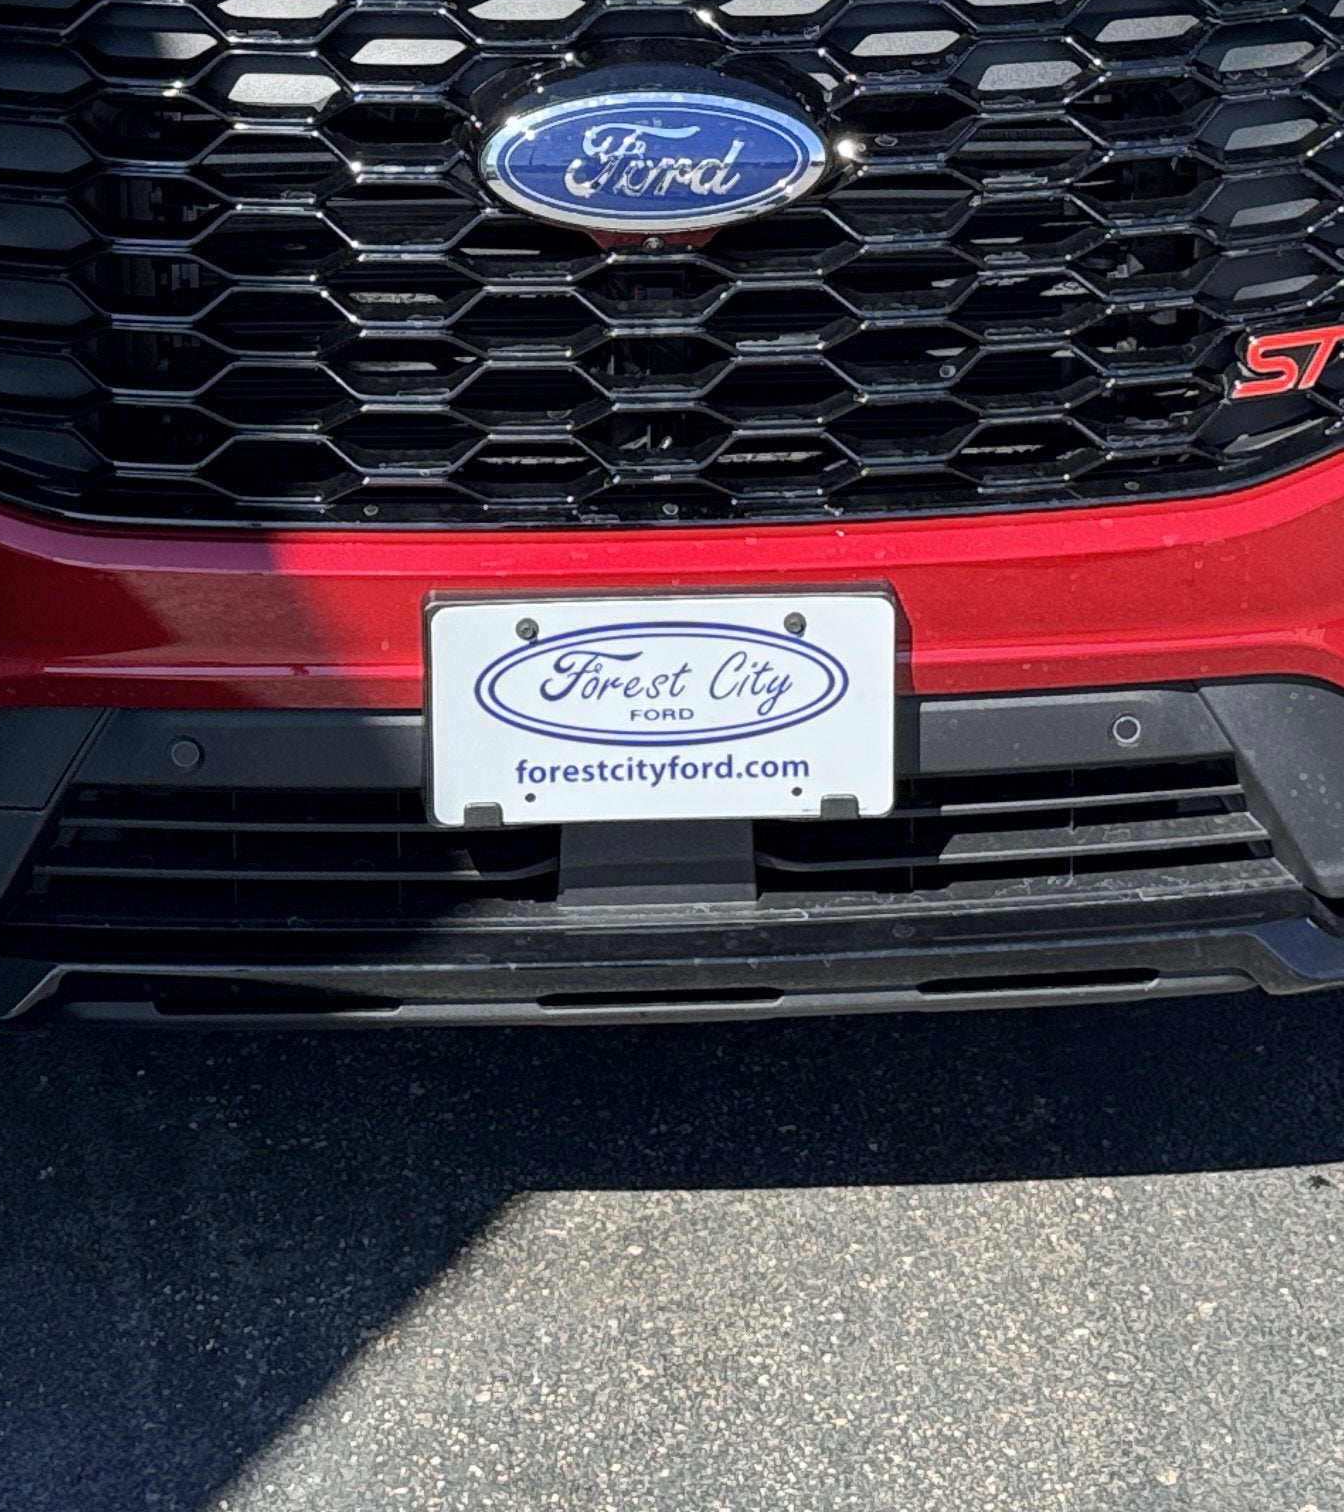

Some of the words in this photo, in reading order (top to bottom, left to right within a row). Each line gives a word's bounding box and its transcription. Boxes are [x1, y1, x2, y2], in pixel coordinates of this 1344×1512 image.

[563, 121, 745, 198] Ford
[539, 649, 693, 702] Forest
[709, 650, 793, 717] City
[629, 707, 695, 721] FORD
[515, 753, 810, 788] forestcityford.com
